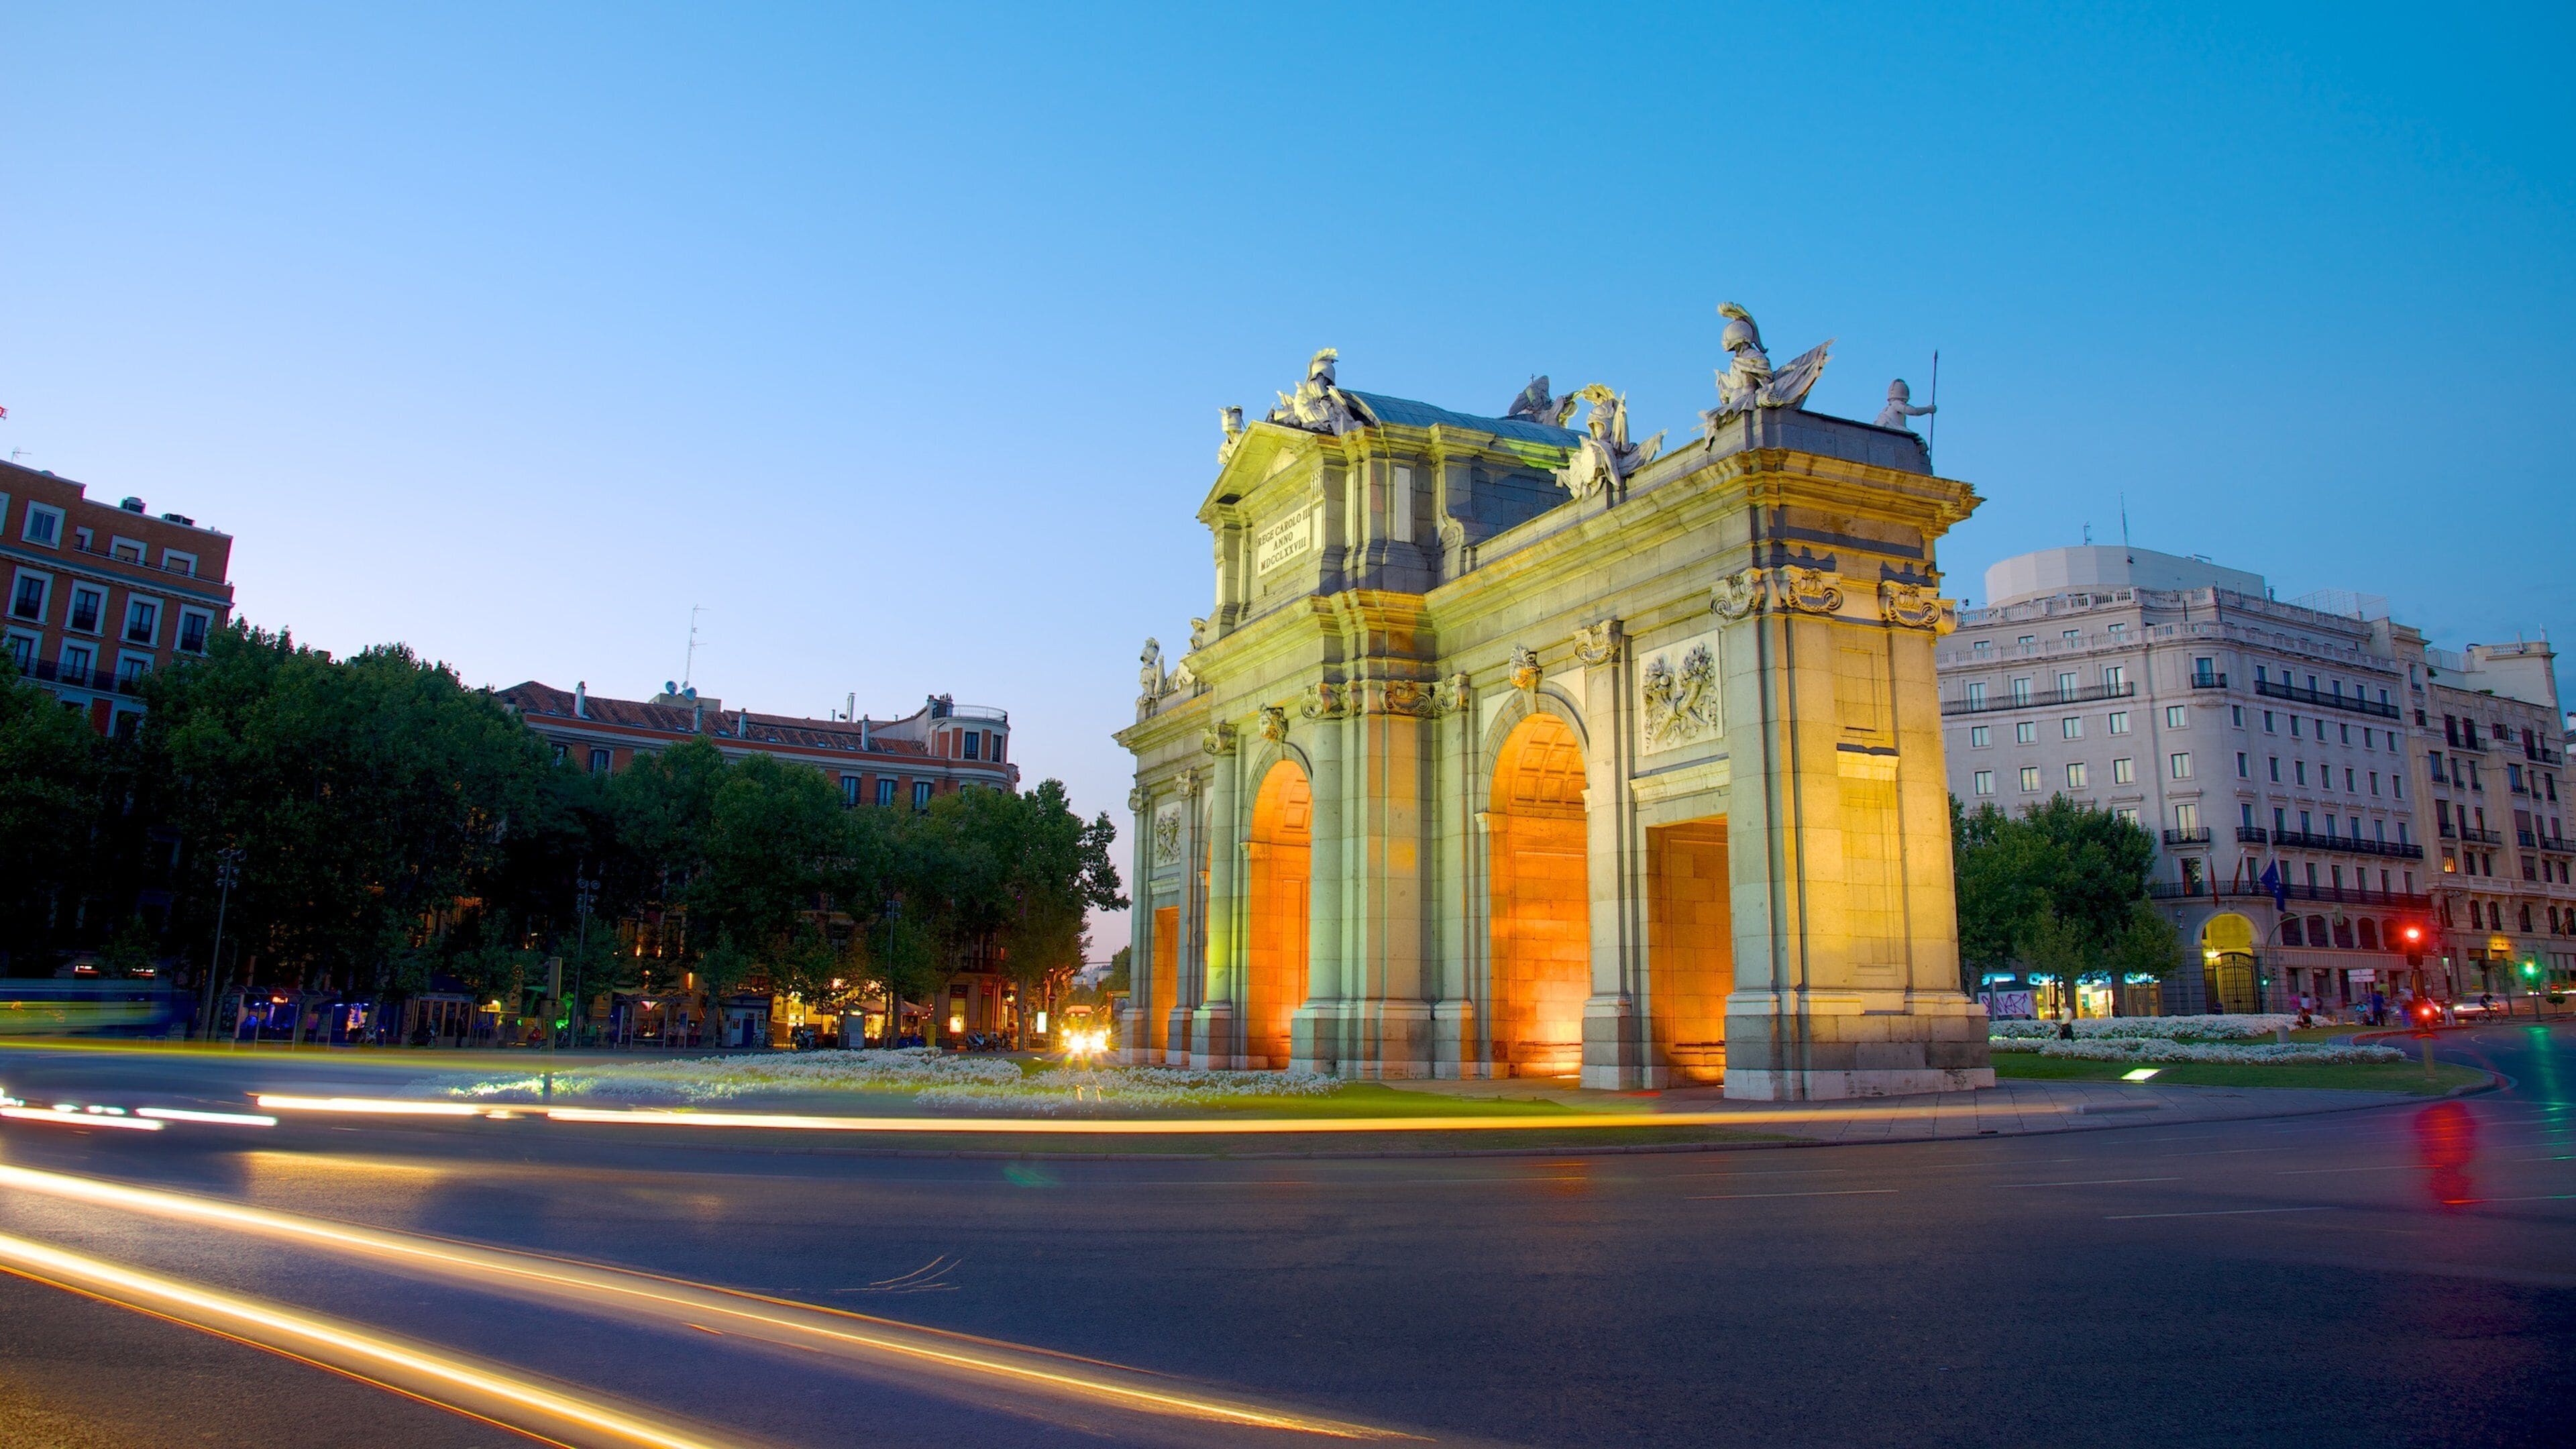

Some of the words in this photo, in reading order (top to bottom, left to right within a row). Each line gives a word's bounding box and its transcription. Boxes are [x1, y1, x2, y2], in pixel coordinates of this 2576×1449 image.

[1257, 529, 1275, 547] REGE
[1275, 513, 1301, 536] CAROLO
[1303, 506, 1311, 521] III
[1273, 531, 1293, 551] ANNO
[1260, 537, 1306, 572] MDCCLXXVIII
